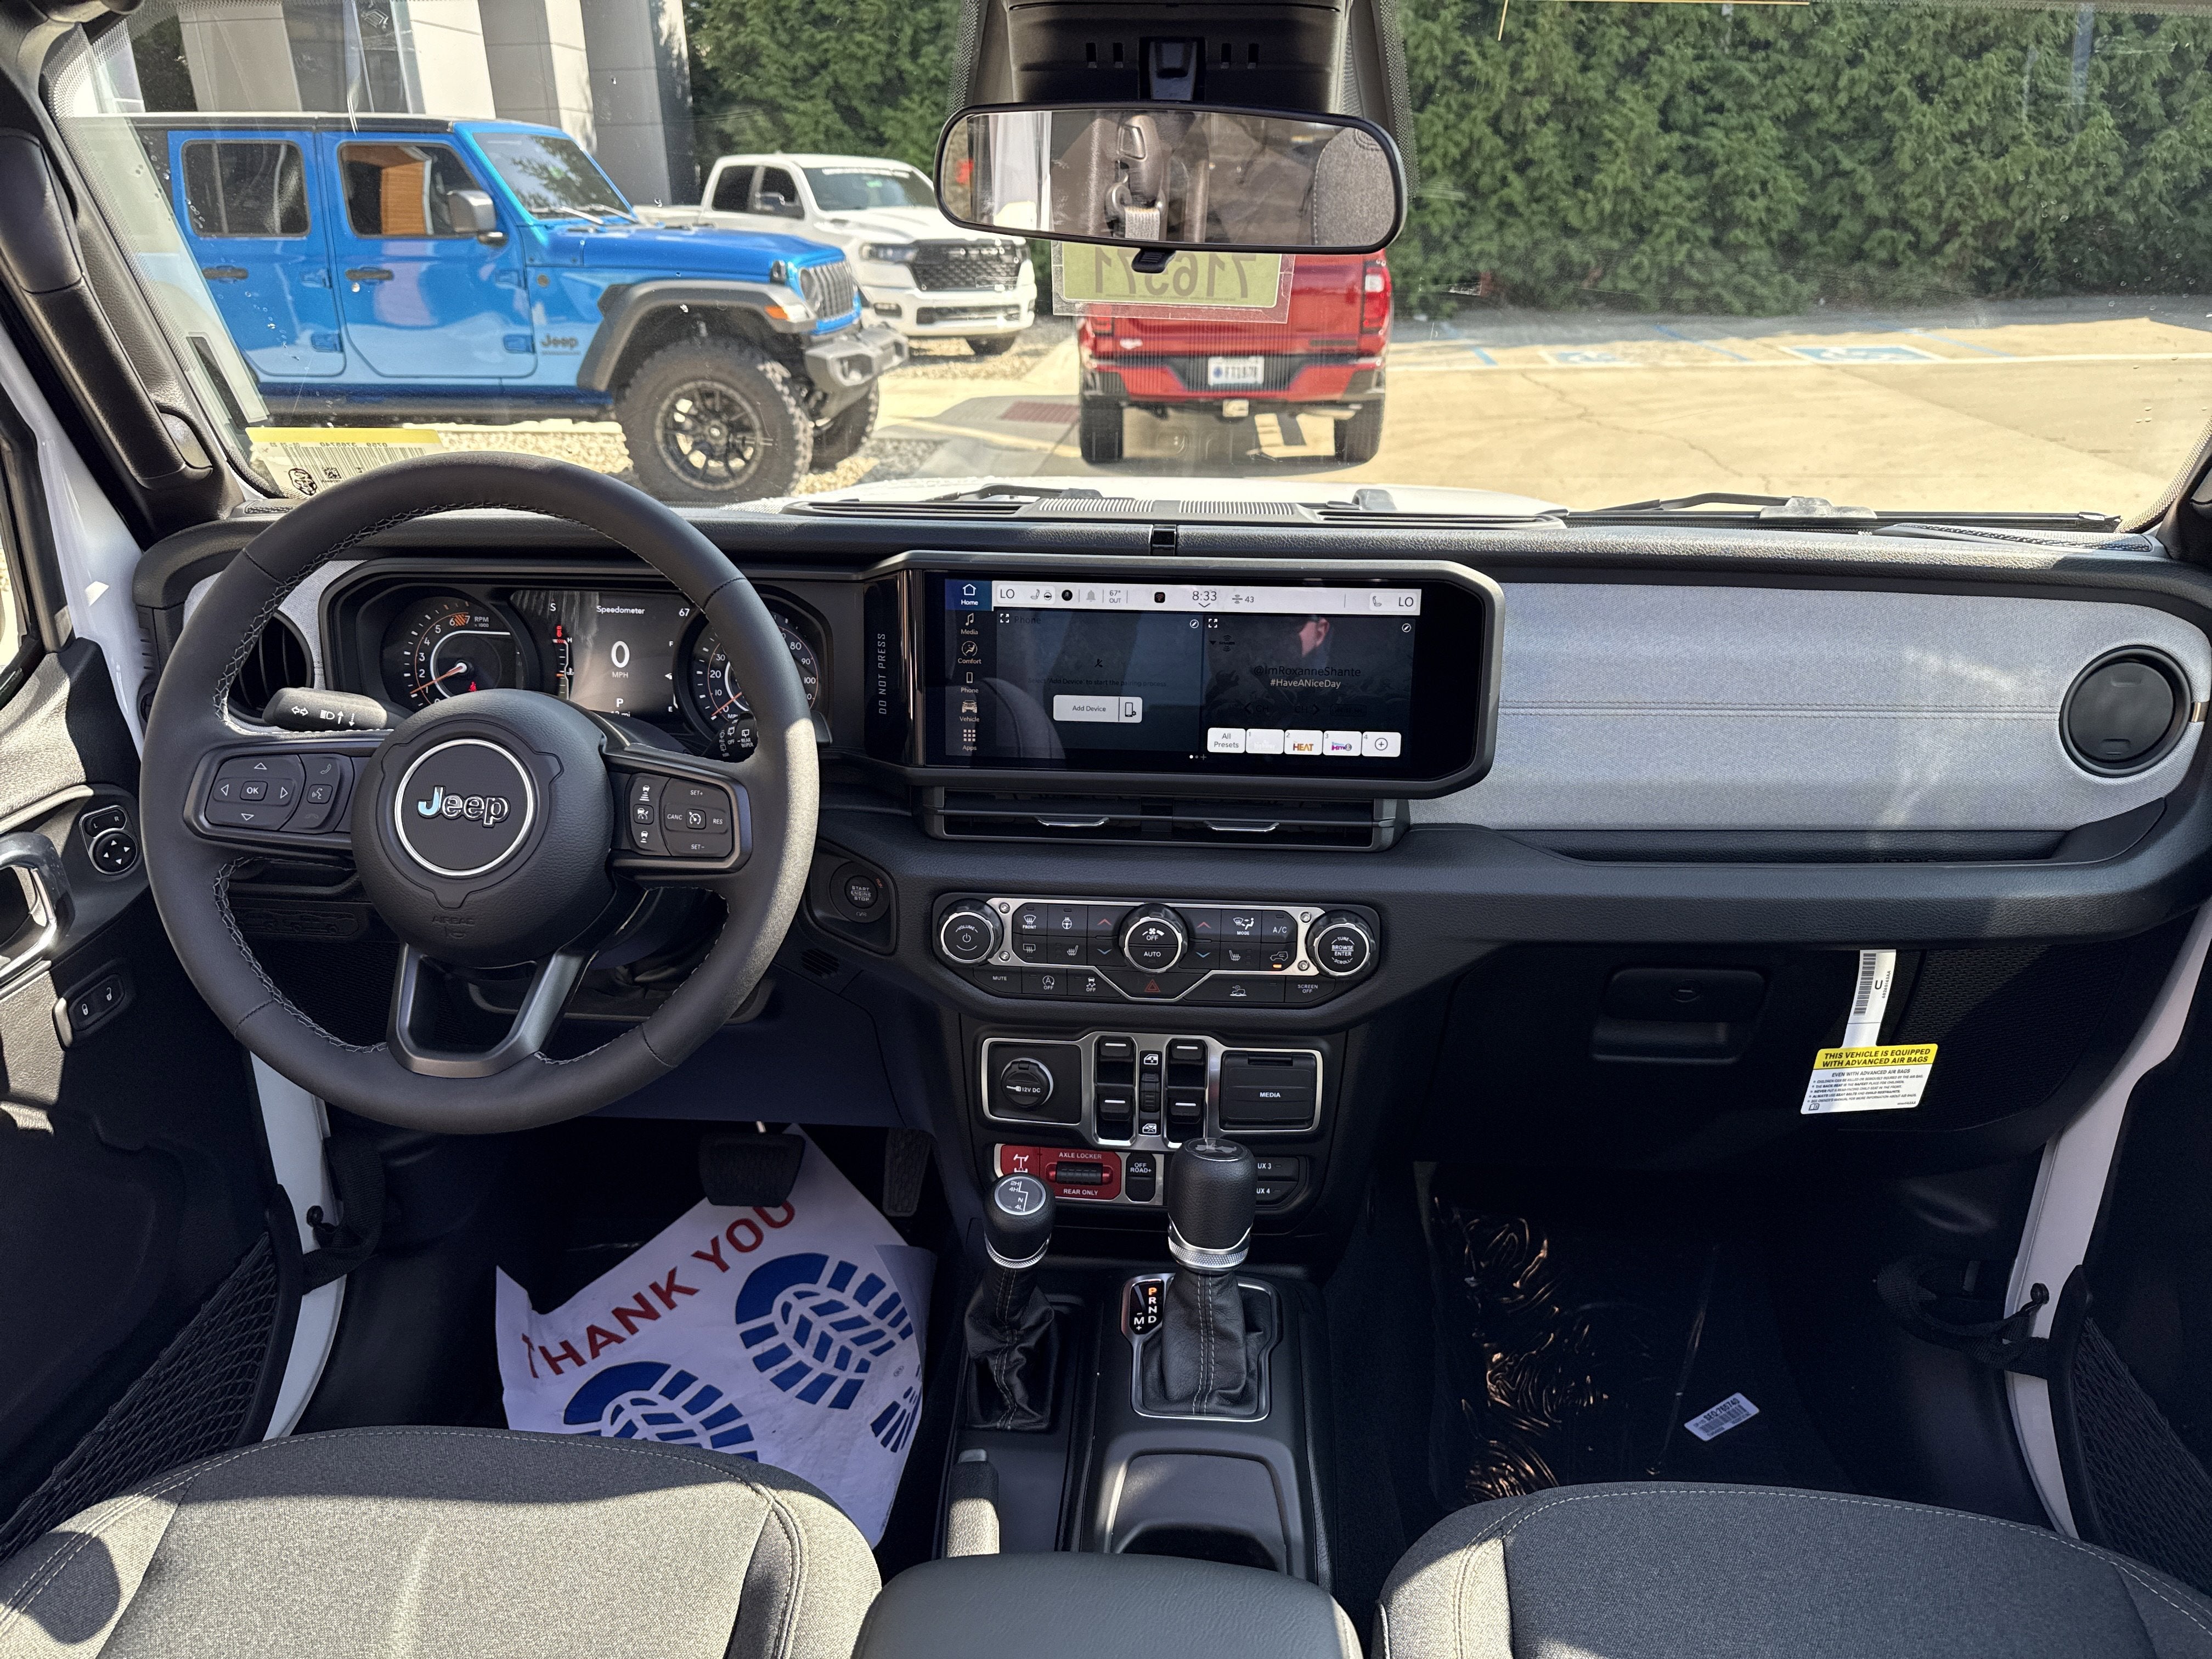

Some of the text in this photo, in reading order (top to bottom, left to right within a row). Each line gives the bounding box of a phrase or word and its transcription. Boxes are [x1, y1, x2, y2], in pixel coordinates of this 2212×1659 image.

[541, 334, 578, 350] Jeep
[1000, 589, 1015, 599] LO
[1192, 591, 1217, 601] 8:33
[1398, 597, 1414, 607] LO
[550, 603, 556, 612] S
[596, 605, 645, 615] Speedometer
[679, 608, 690, 617] 67
[449, 618, 455, 626] 6
[465, 615, 471, 624] 7
[1015, 616, 1042, 624] Phone
[435, 624, 442, 634] 5
[424, 637, 431, 646] 4
[790, 642, 802, 651] 80
[419, 652, 425, 662] 3
[611, 640, 630, 668] 0
[419, 669, 425, 678] 2
[710, 670, 721, 679] 20
[878, 633, 887, 714] DO NOT PRESS
[1270, 679, 1341, 690] #HaveANiceDay
[616, 698, 624, 708] P
[1293, 743, 1314, 752] HEAT
[417, 786, 511, 828] Jeep
[1273, 926, 1287, 934] A/C
[1845, 1051, 1878, 1059] VEHICLE
[1844, 1058, 1890, 1066] ADVANCED
[521, 1200, 796, 1379] THANK YOU
[1148, 1287, 1157, 1296] P
[1148, 1296, 1157, 1305] R
[1148, 1306, 1158, 1314] N
[1133, 1317, 1144, 1325] M
[1148, 1316, 1157, 1324] D
